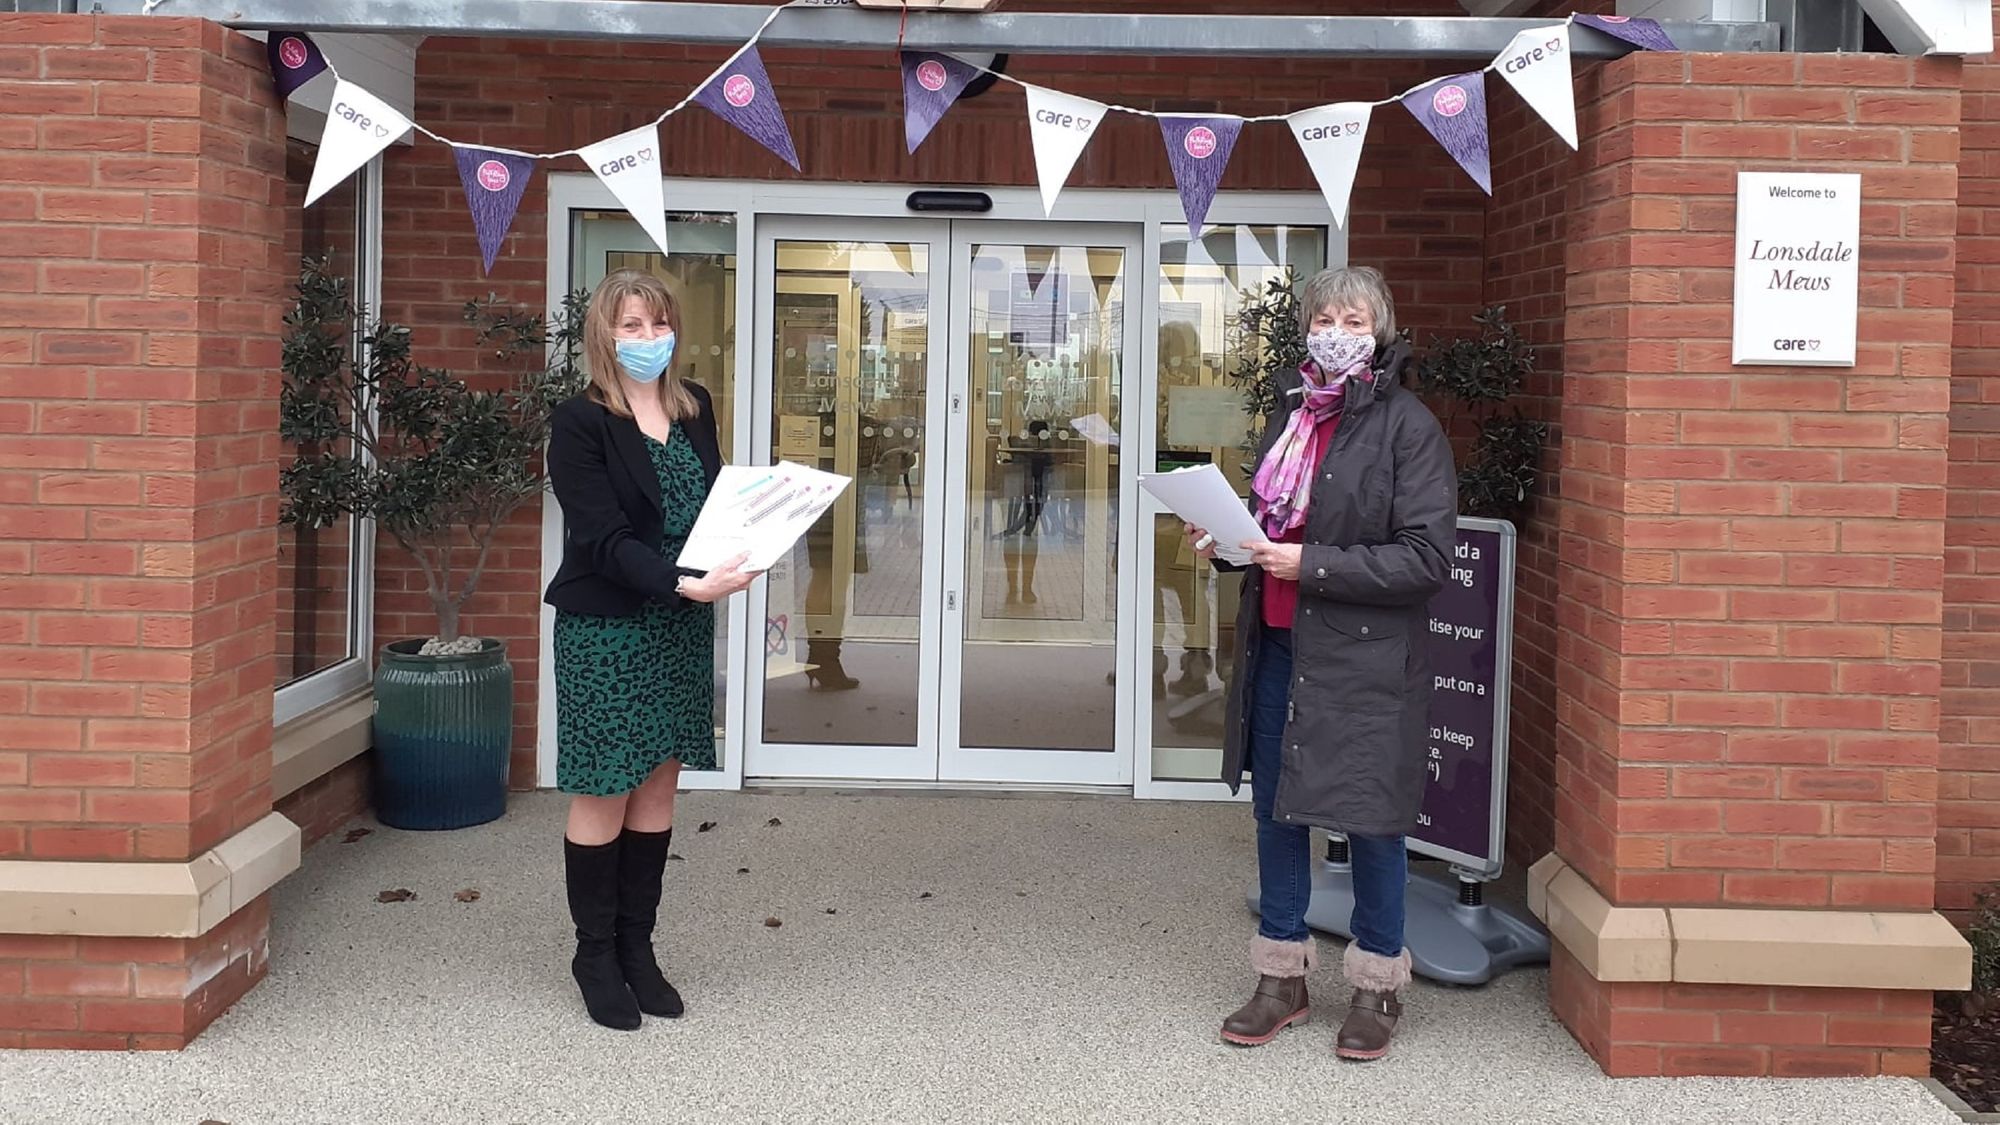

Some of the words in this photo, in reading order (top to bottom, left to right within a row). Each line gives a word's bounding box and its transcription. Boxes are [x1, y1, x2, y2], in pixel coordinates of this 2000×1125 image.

[1505, 48, 1544, 73] care
[335, 102, 371, 130] care
[1036, 109, 1072, 127] care
[1302, 125, 1341, 140] care
[600, 155, 637, 176] care
[1769, 186, 1822, 198] Welcome
[1824, 188, 1836, 198] to
[1749, 240, 1853, 261] Lonsdale
[1767, 269, 1831, 290] Mews
[1774, 339, 1806, 350] care
[1471, 547, 1480, 560] a
[1451, 563, 1473, 587] ing
[1429, 617, 1452, 635] tise
[1454, 625, 1484, 641] your
[1434, 675, 1457, 691] put
[1458, 680, 1474, 693] on
[1477, 684, 1485, 695] a
[1443, 725, 1474, 751] keep
